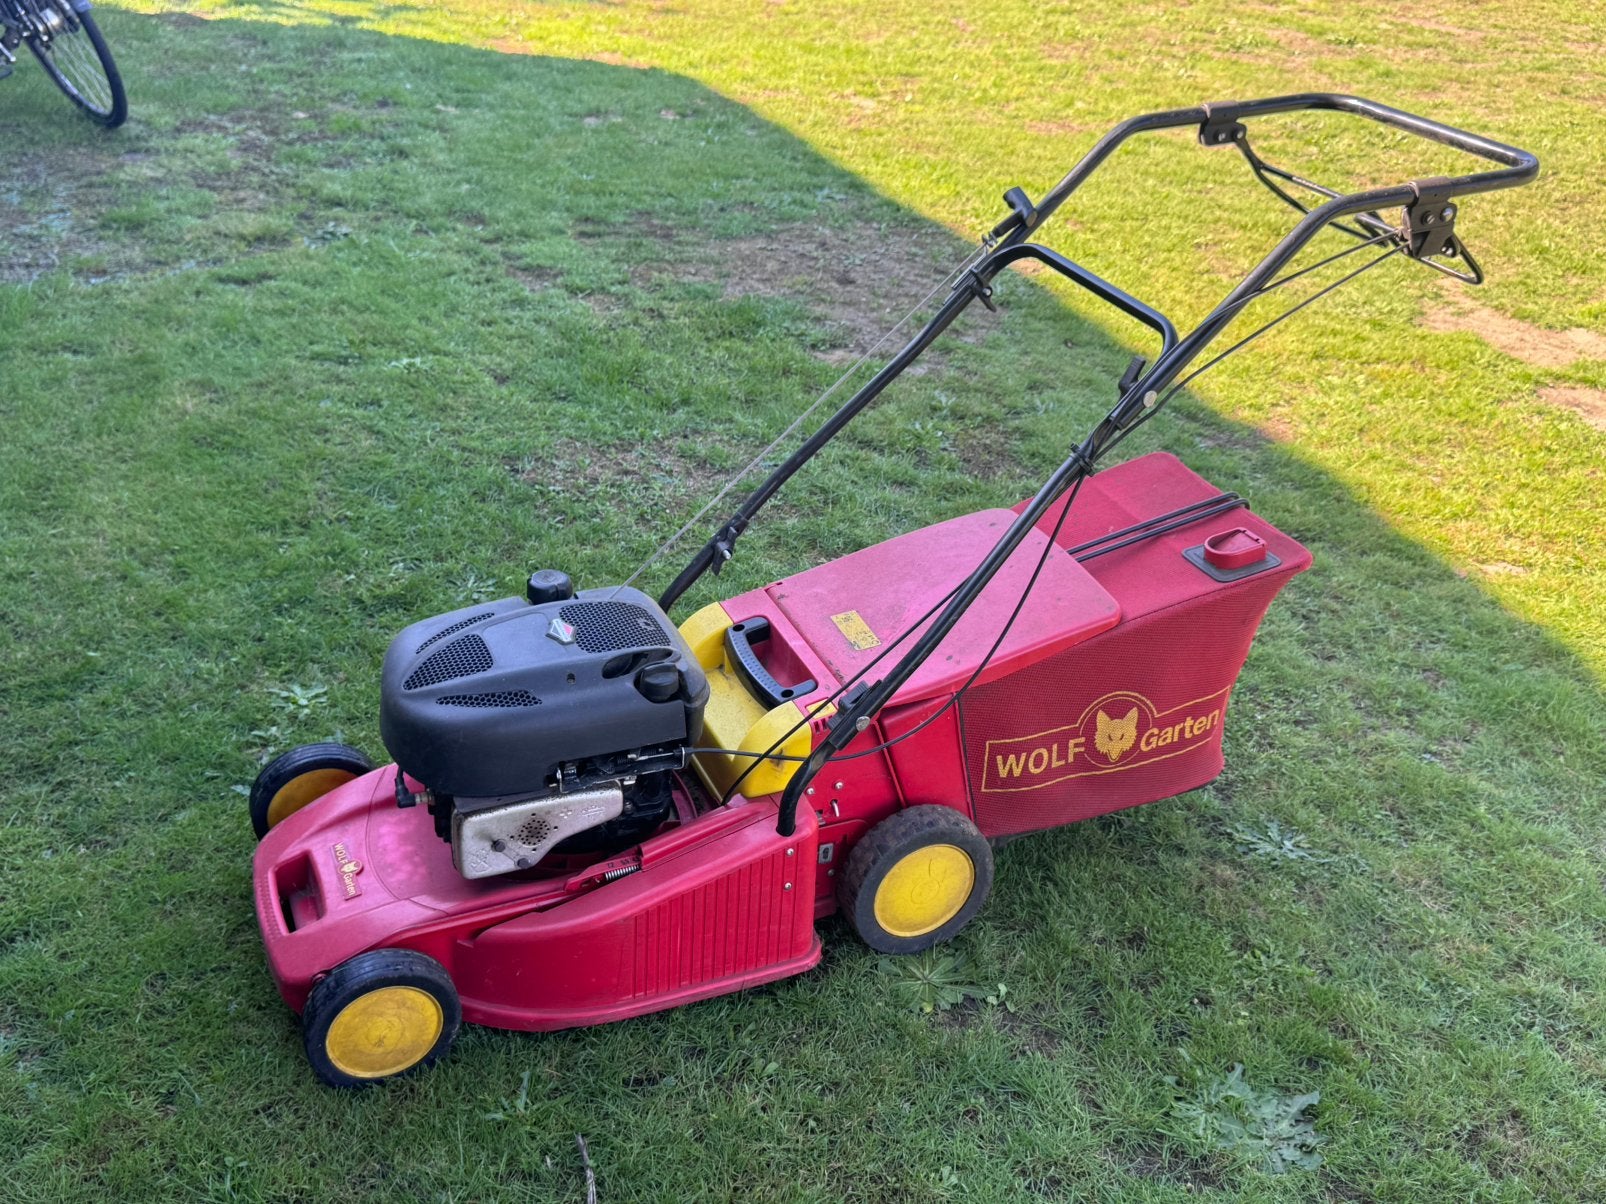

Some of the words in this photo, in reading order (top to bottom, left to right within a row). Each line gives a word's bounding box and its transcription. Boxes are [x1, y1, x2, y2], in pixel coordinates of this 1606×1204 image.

[996, 737, 1086, 778] WOLF
[1140, 709, 1220, 752] Garten
[335, 842, 348, 864] WOLF
[344, 872, 356, 896] Garten
